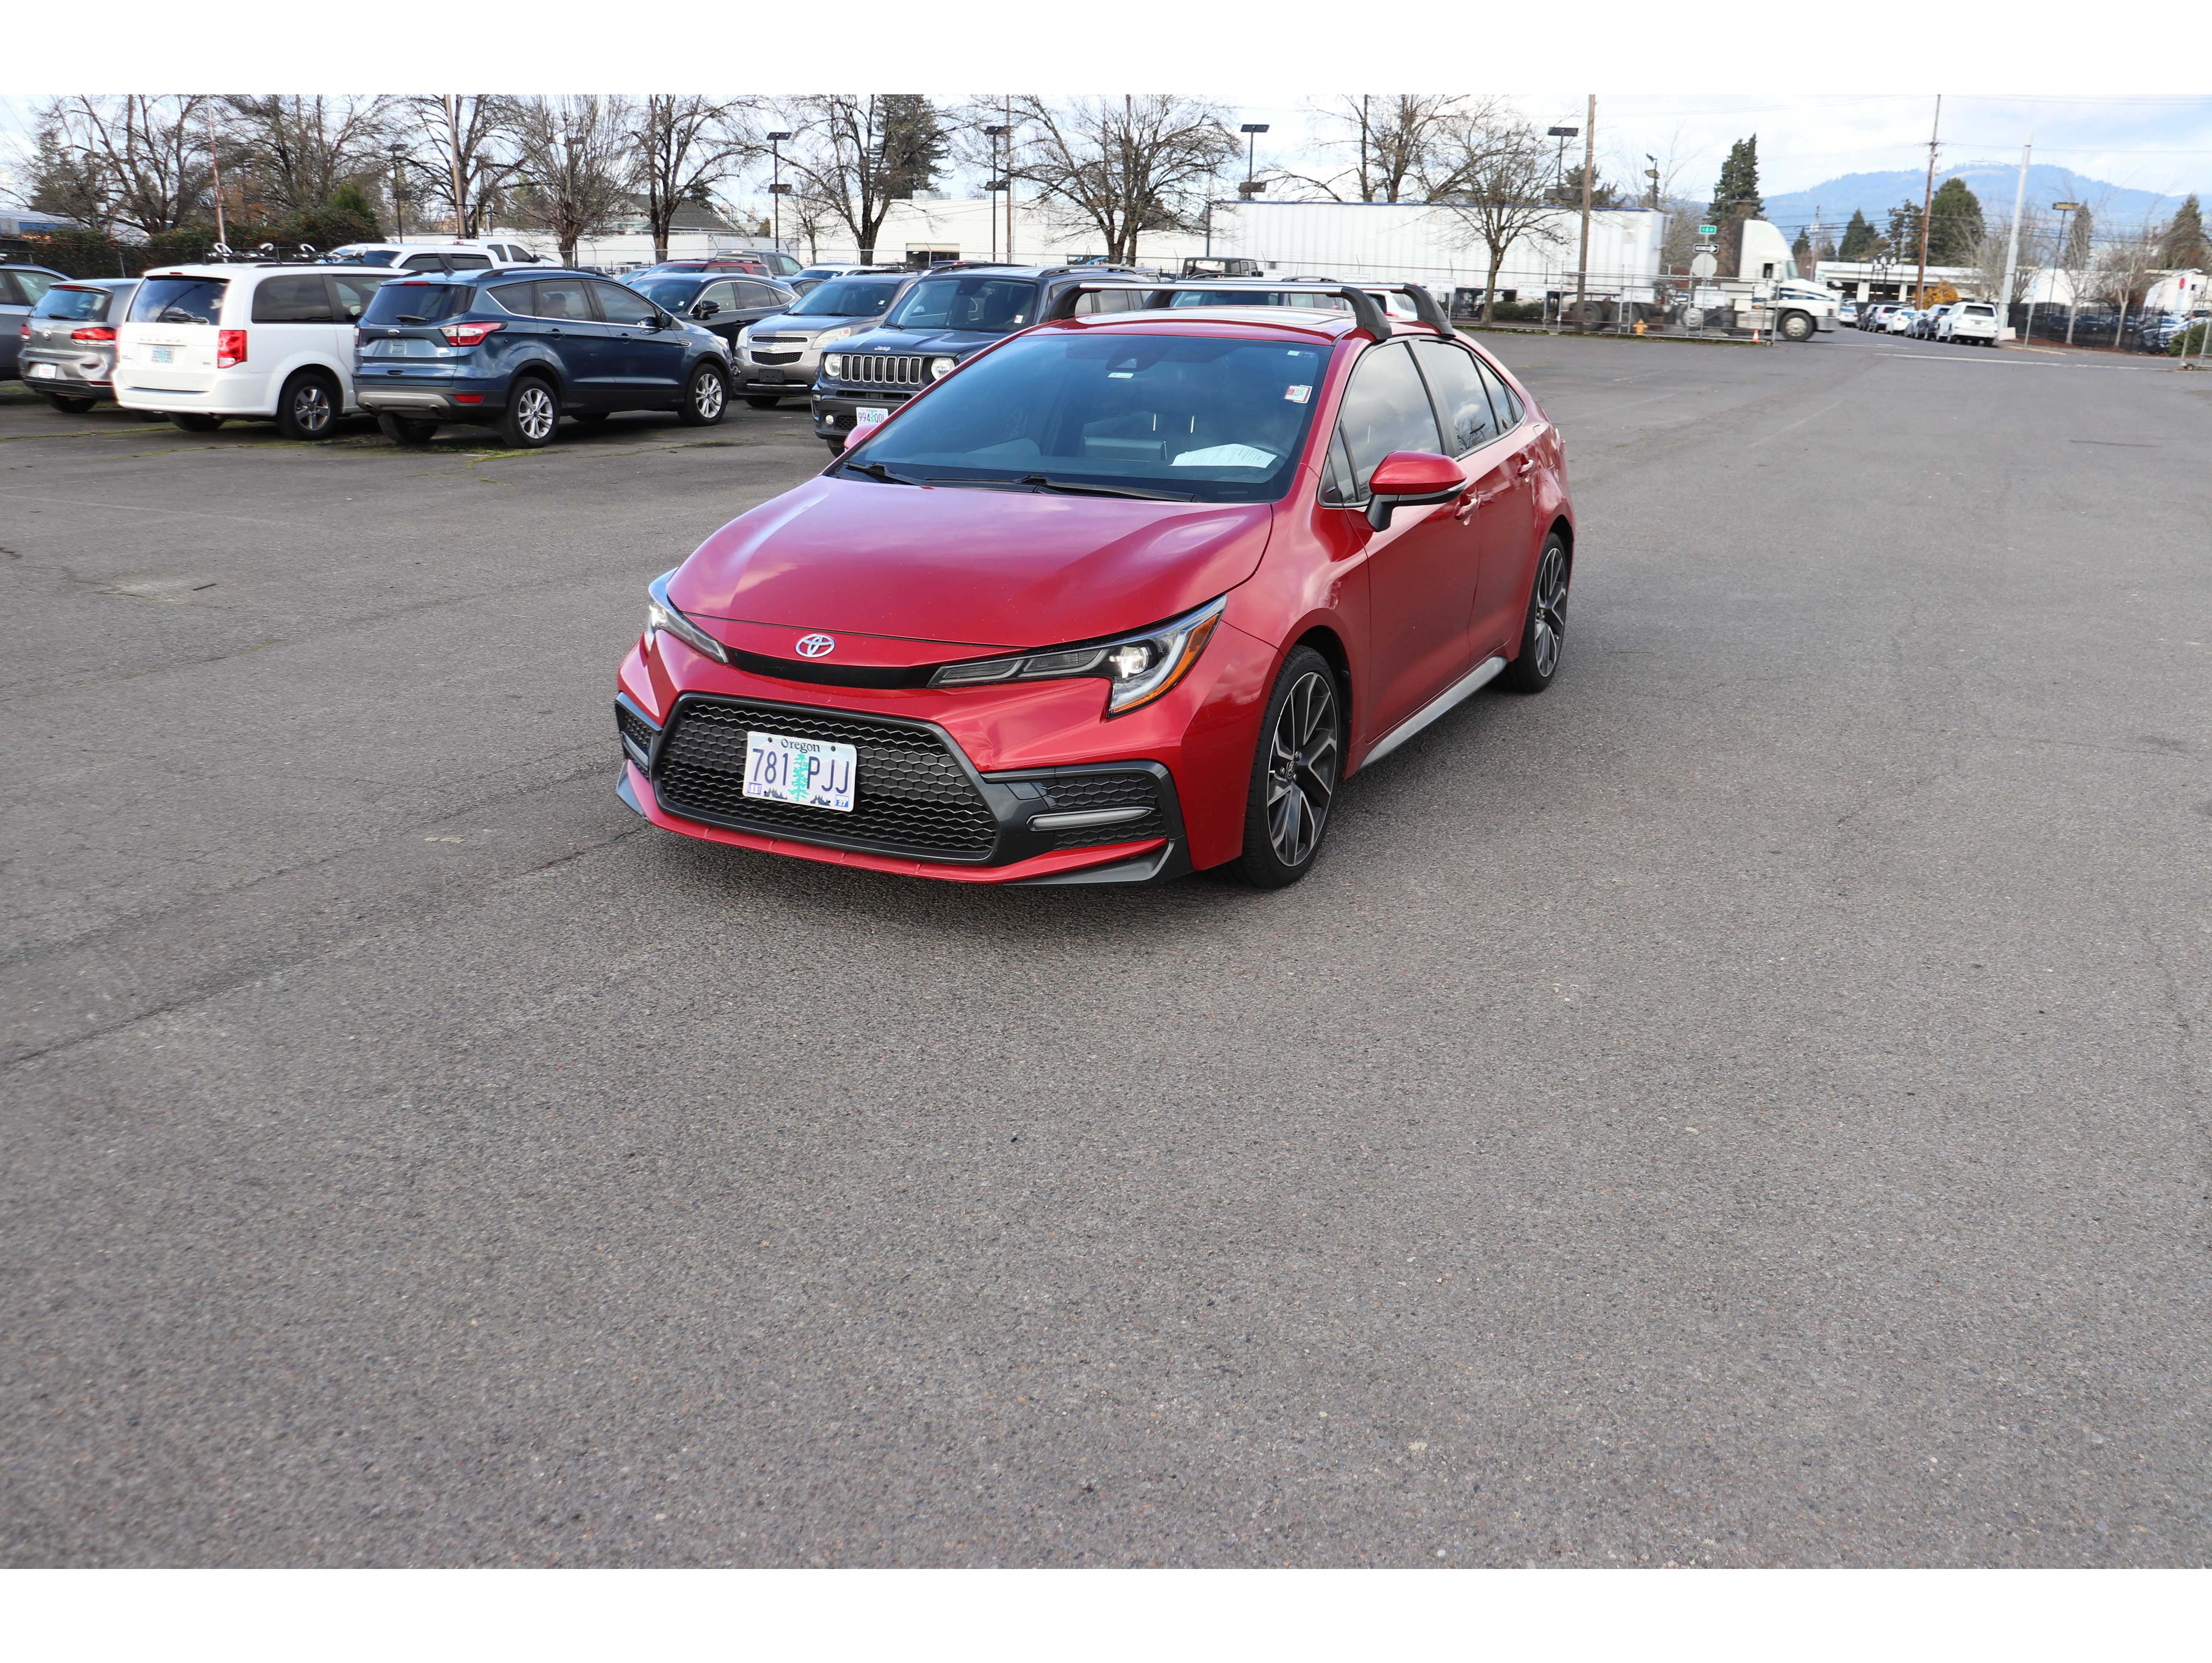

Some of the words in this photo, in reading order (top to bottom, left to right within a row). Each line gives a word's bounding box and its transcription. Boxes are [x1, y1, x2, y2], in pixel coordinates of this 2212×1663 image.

[858, 413, 870, 422] 994
[781, 738, 821, 754] Oregon
[752, 748, 789, 786] 781
[806, 756, 849, 794] PJJ
[749, 784, 758, 794] 11
